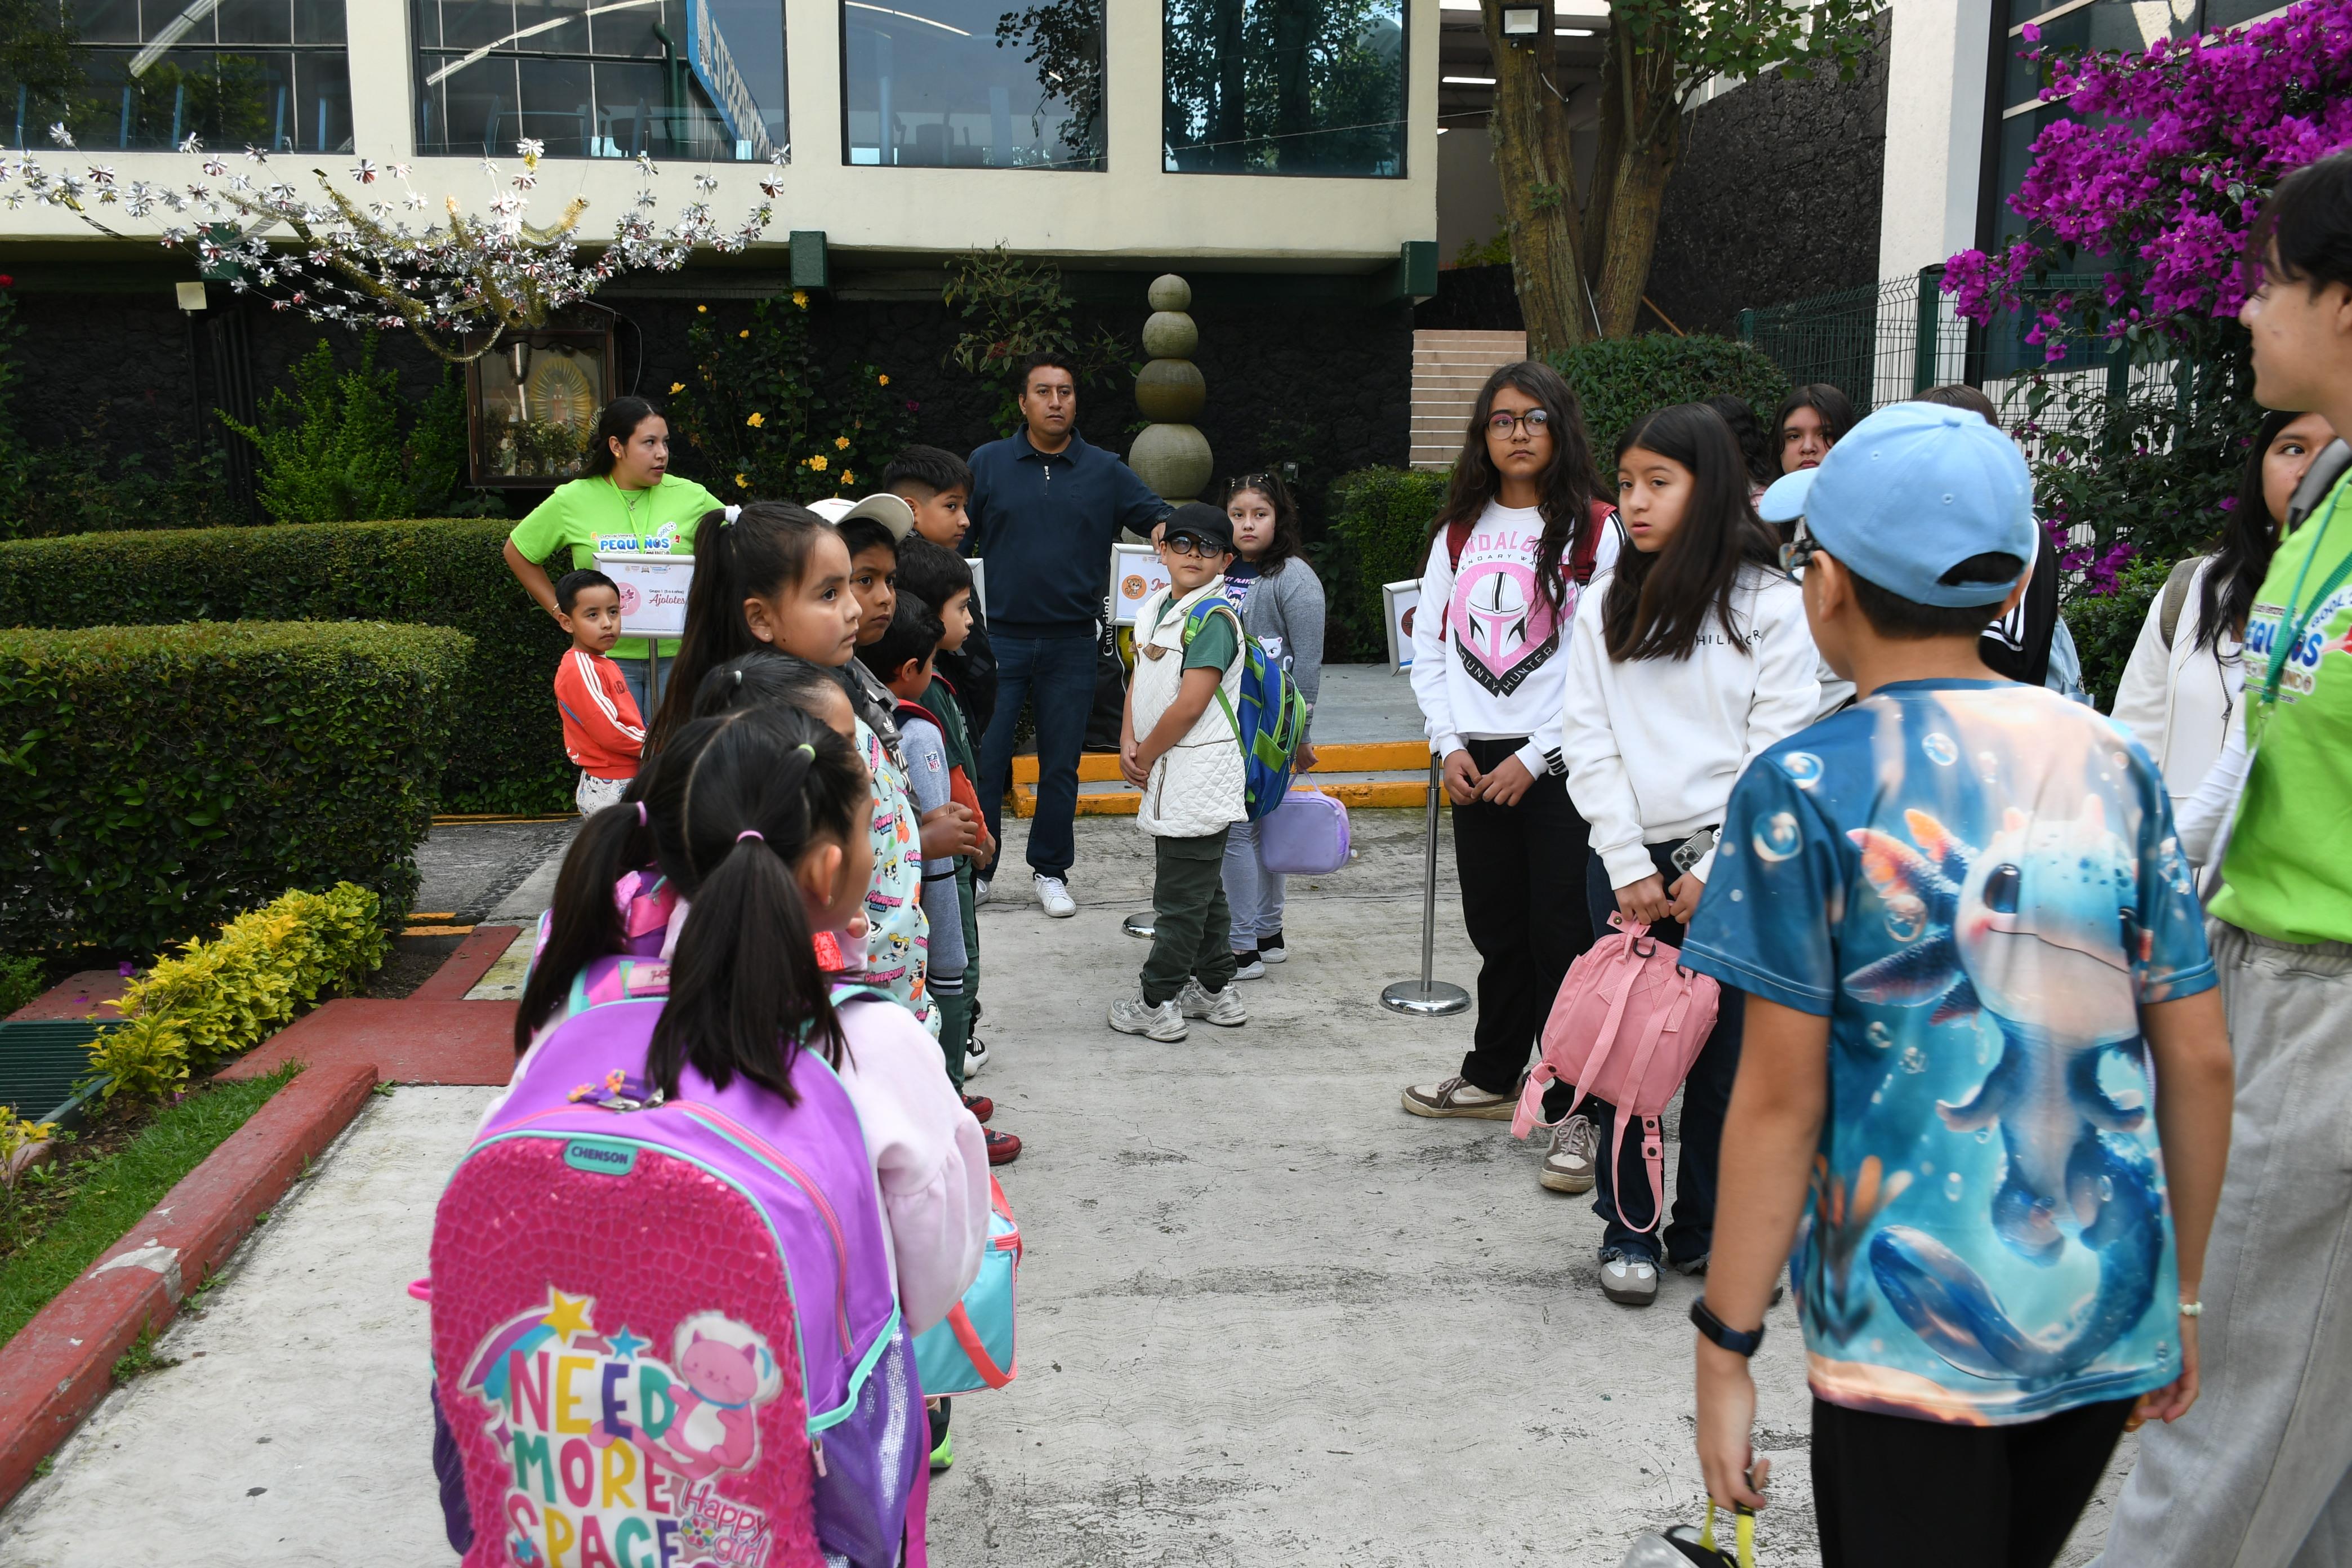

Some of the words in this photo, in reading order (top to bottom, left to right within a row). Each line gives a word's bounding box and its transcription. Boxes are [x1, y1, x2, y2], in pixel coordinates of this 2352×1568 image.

[600, 536, 669, 550] PEQUÑOS
[649, 594, 685, 607] Ajolotes
[1503, 646, 1553, 691] HUNTER
[929, 759, 939, 769] NFL
[866, 890, 903, 907] POWERPUFF
[870, 903, 887, 912] GIRLS
[865, 965, 906, 982] POWERPUFF
[571, 1145, 629, 1165] CHENSON
[510, 1349, 678, 1440] NEED
[513, 1429, 671, 1514] MORE
[684, 1480, 772, 1544] Happy
[713, 1535, 768, 1567] girl
